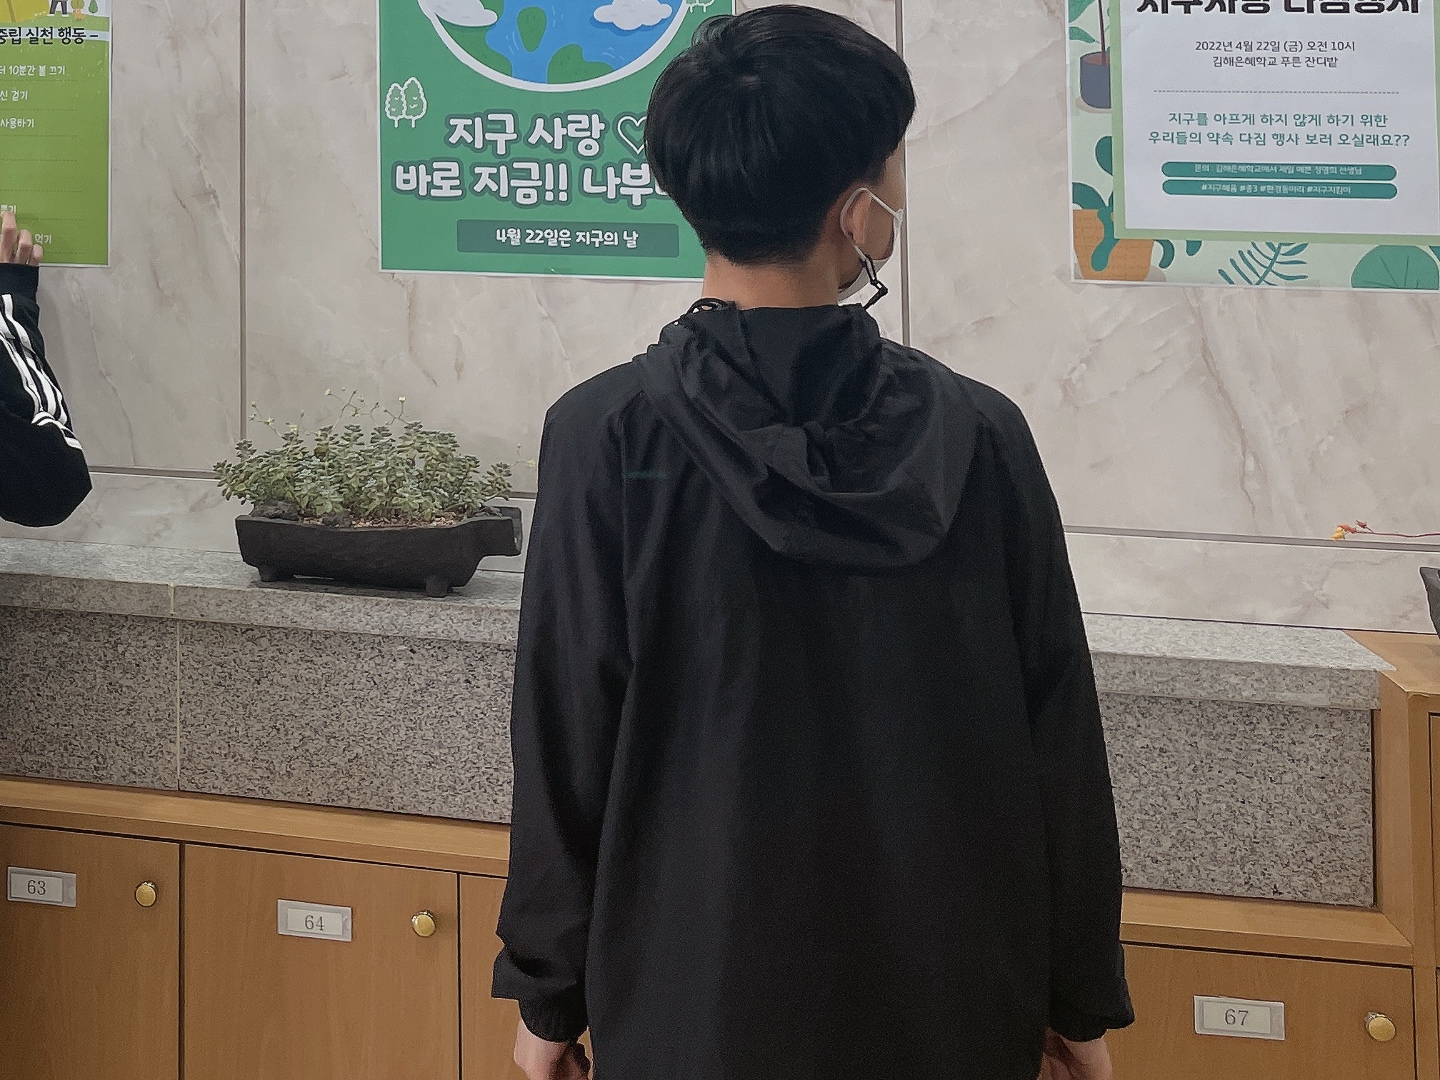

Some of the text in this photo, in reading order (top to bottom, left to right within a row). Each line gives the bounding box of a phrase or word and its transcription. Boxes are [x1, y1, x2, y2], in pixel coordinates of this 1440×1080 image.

[26, 27, 54, 45] 실천
[58, 27, 86, 45] 행동
[1195, 40, 1234, 52] 2022년
[1236, 40, 1253, 52] 4월
[1256, 40, 1280, 52] 22일
[1306, 41, 1328, 52] 오전
[1330, 41, 1355, 52] 10시
[1212, 56, 1338, 68] 김해은혜학교 푸른 잔디밭
[0, 118, 35, 129] 사용하기
[1168, 112, 1389, 128] 지구를 아프게 하지 않게 하기 위한
[449, 113, 605, 156] 지구 사랑
[1148, 131, 1410, 148] 우리들의 약속 다짐 행사 보러 오실래요??
[395, 161, 669, 207] 바로 지금!! 나부
[496, 228, 639, 248] 4월 22일은 지구의 날
[27, 880, 46, 895] 63
[305, 915, 325, 931] 64
[1224, 1008, 1249, 1026] 67
